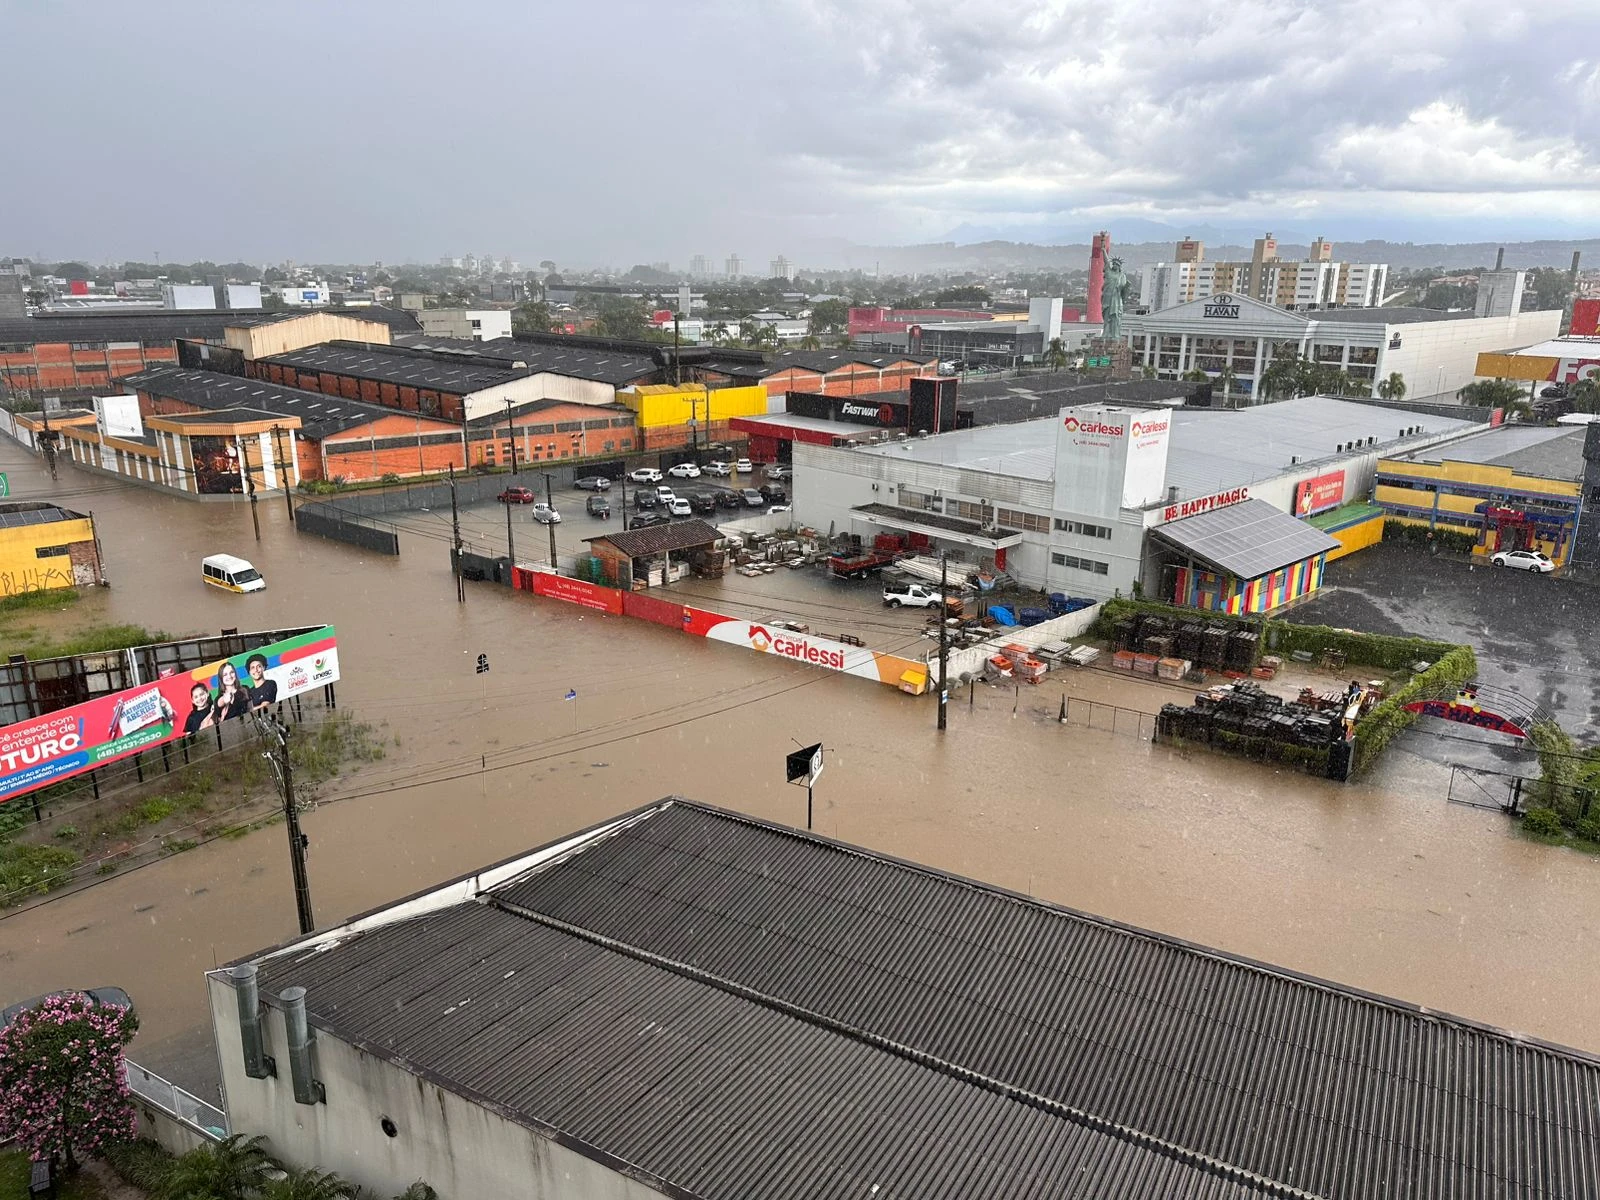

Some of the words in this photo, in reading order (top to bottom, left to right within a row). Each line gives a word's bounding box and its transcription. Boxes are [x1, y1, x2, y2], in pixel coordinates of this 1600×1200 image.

[1204, 306, 1239, 316] HAVAN
[841, 402, 879, 417] FASTWAY
[1080, 422, 1124, 436] carlessi
[1141, 419, 1168, 434] carlessi
[1165, 505, 1178, 521] BE
[1181, 496, 1216, 516] HAPPY
[1217, 487, 1248, 505] MAGIC
[774, 639, 844, 669] carlessi
[313, 669, 333, 680] unesc
[12, 723, 49, 738] cresce
[50, 715, 74, 727] com
[0, 716, 84, 771] TURO!
[2, 729, 57, 752] entende
[59, 723, 76, 734] de
[97, 748, 115, 760] (48)
[41, 764, 54, 772] ANO
